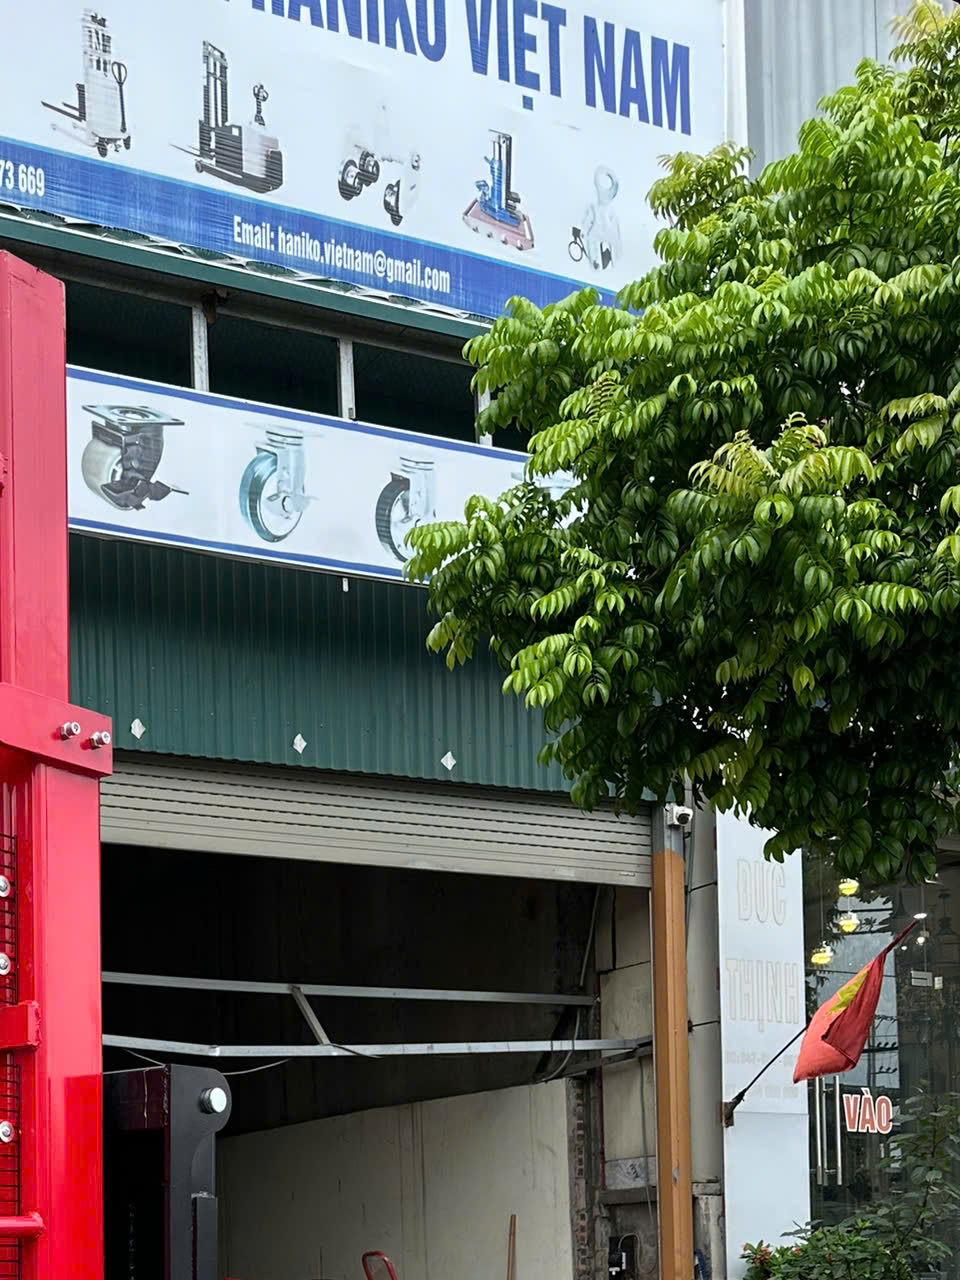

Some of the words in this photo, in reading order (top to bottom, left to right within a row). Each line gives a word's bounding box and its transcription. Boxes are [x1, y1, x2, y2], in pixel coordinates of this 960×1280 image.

[584, 15, 692, 136] NAM
[18, 164, 46, 198] 669
[233, 215, 275, 252] Email:
[277, 227, 451, 294] haniko.vietnam@gmail.com
[843, 1087, 893, 1135] VÀO
